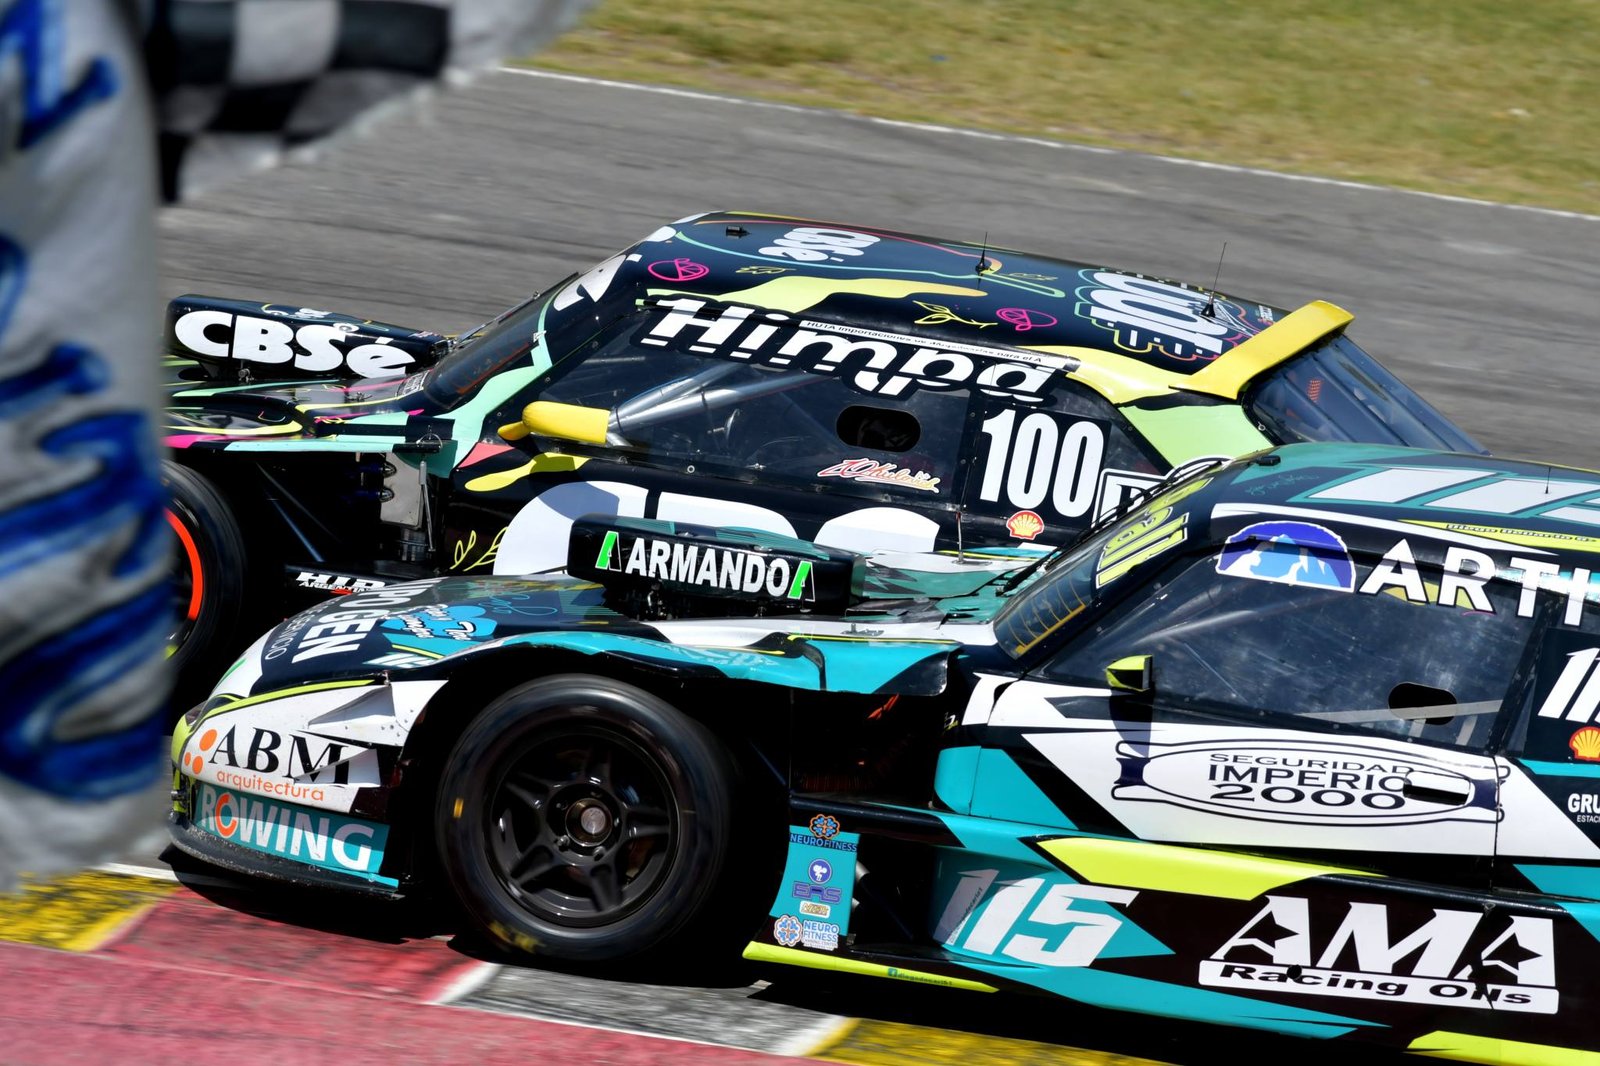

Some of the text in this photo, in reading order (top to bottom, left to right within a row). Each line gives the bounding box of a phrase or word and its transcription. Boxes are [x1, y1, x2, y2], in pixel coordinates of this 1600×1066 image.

[1090, 271, 1228, 355] 100
[175, 310, 416, 379] CBSé
[641, 299, 1054, 401] Himpa
[979, 409, 1104, 517] 100
[625, 537, 791, 597] ARMANDO
[292, 609, 392, 664] GEN
[208, 724, 350, 788] ABM
[216, 770, 324, 802] arquitectura
[1208, 764, 1412, 792] IMPERIO
[1210, 753, 1414, 774] SEGURIDAD
[1210, 783, 1406, 810] 2000
[200, 785, 375, 871] ROWING
[803, 931, 838, 943] FITNESS
[804, 921, 839, 933] NEURO
[933, 869, 1140, 967] 115
[1208, 895, 1557, 987] AMA
[1219, 965, 1409, 998] Racing
